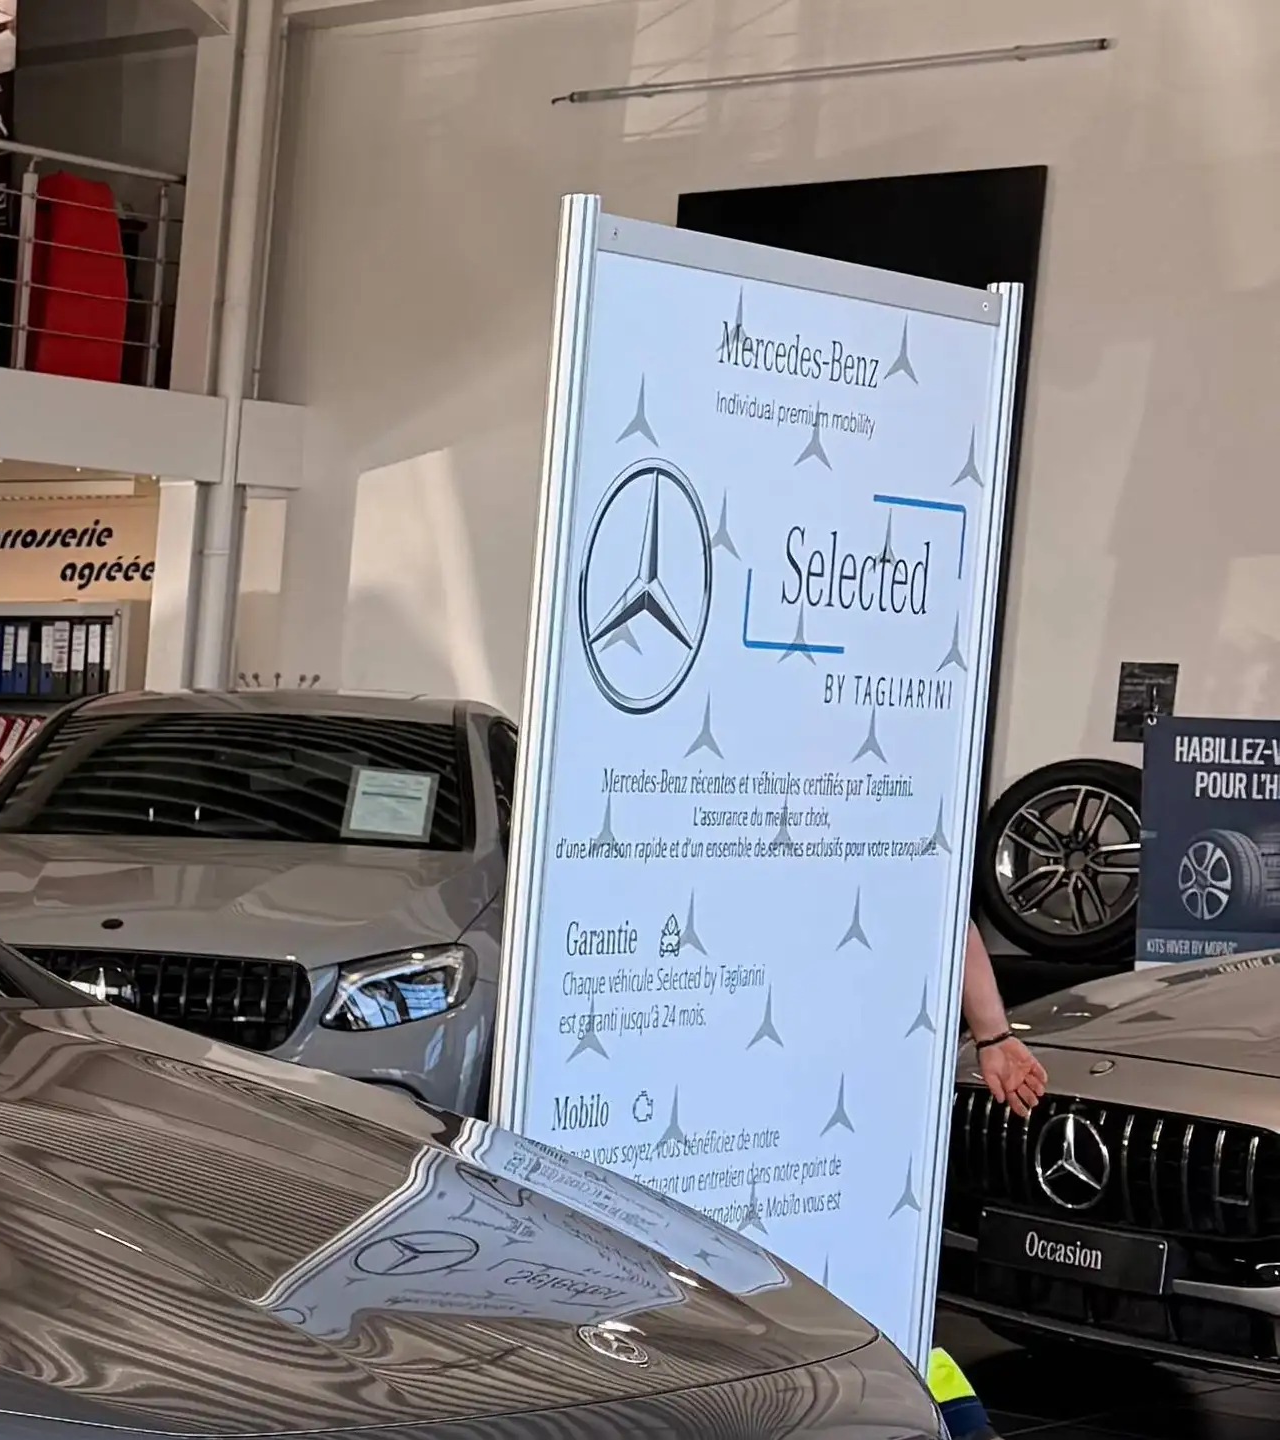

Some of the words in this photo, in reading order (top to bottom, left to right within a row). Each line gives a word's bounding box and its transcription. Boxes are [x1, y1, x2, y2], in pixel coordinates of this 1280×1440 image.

[718, 321, 879, 389] Mercedes-Benz
[716, 390, 774, 420] Individual
[777, 405, 828, 428] premium
[832, 409, 876, 440] mobility
[59, 555, 155, 590] agréée
[781, 526, 930, 615] Selected
[823, 674, 845, 704] BY
[853, 675, 953, 710] TAGLIARINI
[601, 768, 688, 793] Mercedes-Benz
[690, 768, 736, 794] récentes
[738, 774, 749, 794] et
[753, 771, 801, 795] véhicules
[803, 772, 844, 796] certifiés
[845, 778, 863, 801] par
[866, 773, 913, 801] Tagliarini.
[1195, 771, 1247, 799] POUR
[1252, 773, 1280, 800] L'H
[693, 806, 748, 826] L'assurance
[750, 806, 763, 826] du
[556, 838, 586, 859] d'une
[588, 838, 632, 859] livraison
[634, 837, 668, 863] rapide
[670, 839, 679, 858] et
[681, 837, 703, 858] d'un
[706, 837, 752, 858] ensemble
[754, 837, 766, 858] de
[806, 837, 843, 858] exclusifs
[844, 842, 865, 862] pour
[867, 841, 889, 858] votre
[566, 920, 638, 956] Garantie
[1146, 939, 1165, 954] KITS
[1166, 940, 1190, 955] HIVER
[1191, 940, 1204, 956] BY
[562, 971, 606, 1000] Chaque
[608, 967, 653, 993] véhicule
[656, 964, 702, 991] Selected
[704, 964, 717, 995] by
[719, 964, 766, 994] Tagliarini
[559, 1012, 576, 1034] est
[577, 1007, 617, 1040] garanti
[619, 1005, 659, 1037] jusqu'à
[661, 1005, 676, 1028] 24
[679, 1003, 706, 1027] mois.
[551, 1094, 610, 1131] Mobilo
[593, 1146, 620, 1165] vous
[621, 1143, 653, 1169] soyez,
[683, 1129, 735, 1156] bénéficiez
[737, 1128, 751, 1150] de
[752, 1128, 780, 1150] notre
[681, 1175, 695, 1193] un
[697, 1164, 745, 1191] entretien
[746, 1161, 771, 1185] dans
[773, 1161, 800, 1182] notre
[801, 1156, 827, 1185] point
[828, 1154, 842, 1176] de
[766, 1193, 800, 1219] Mobilo
[803, 1193, 825, 1213] vous
[827, 1190, 842, 1210] est
[1025, 1231, 1102, 1270] Occasion
